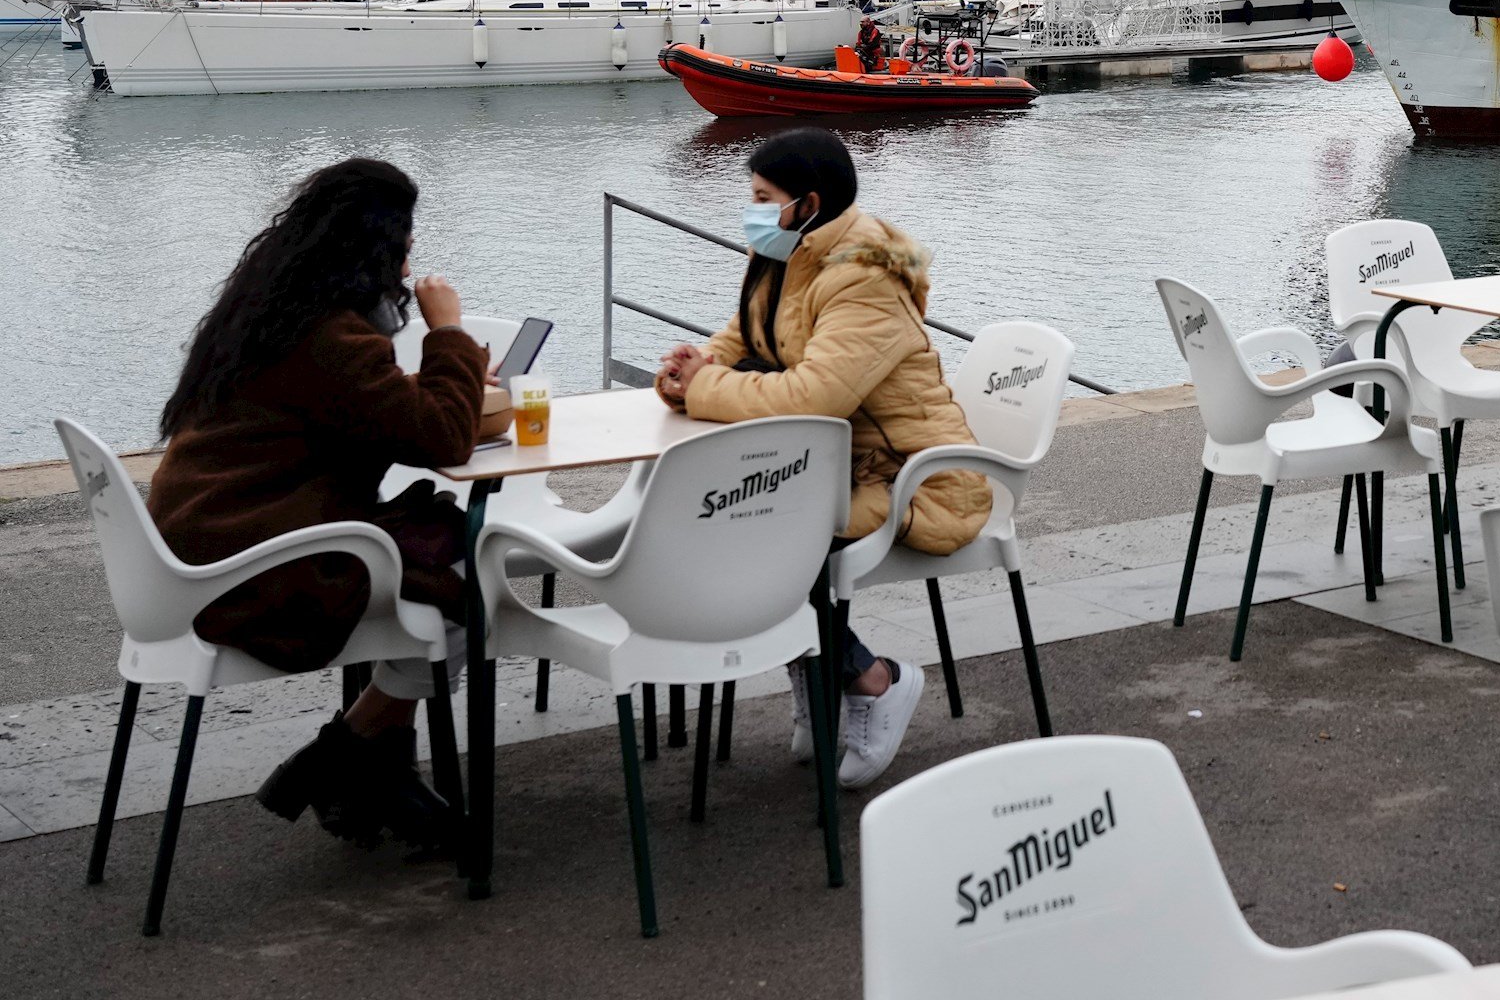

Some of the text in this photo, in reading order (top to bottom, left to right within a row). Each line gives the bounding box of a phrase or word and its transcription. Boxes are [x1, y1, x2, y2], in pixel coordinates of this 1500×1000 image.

[1358, 240, 1415, 284] SanMiguel
[697, 448, 810, 519] SanMiguel
[956, 789, 1116, 926] SanMiguel
